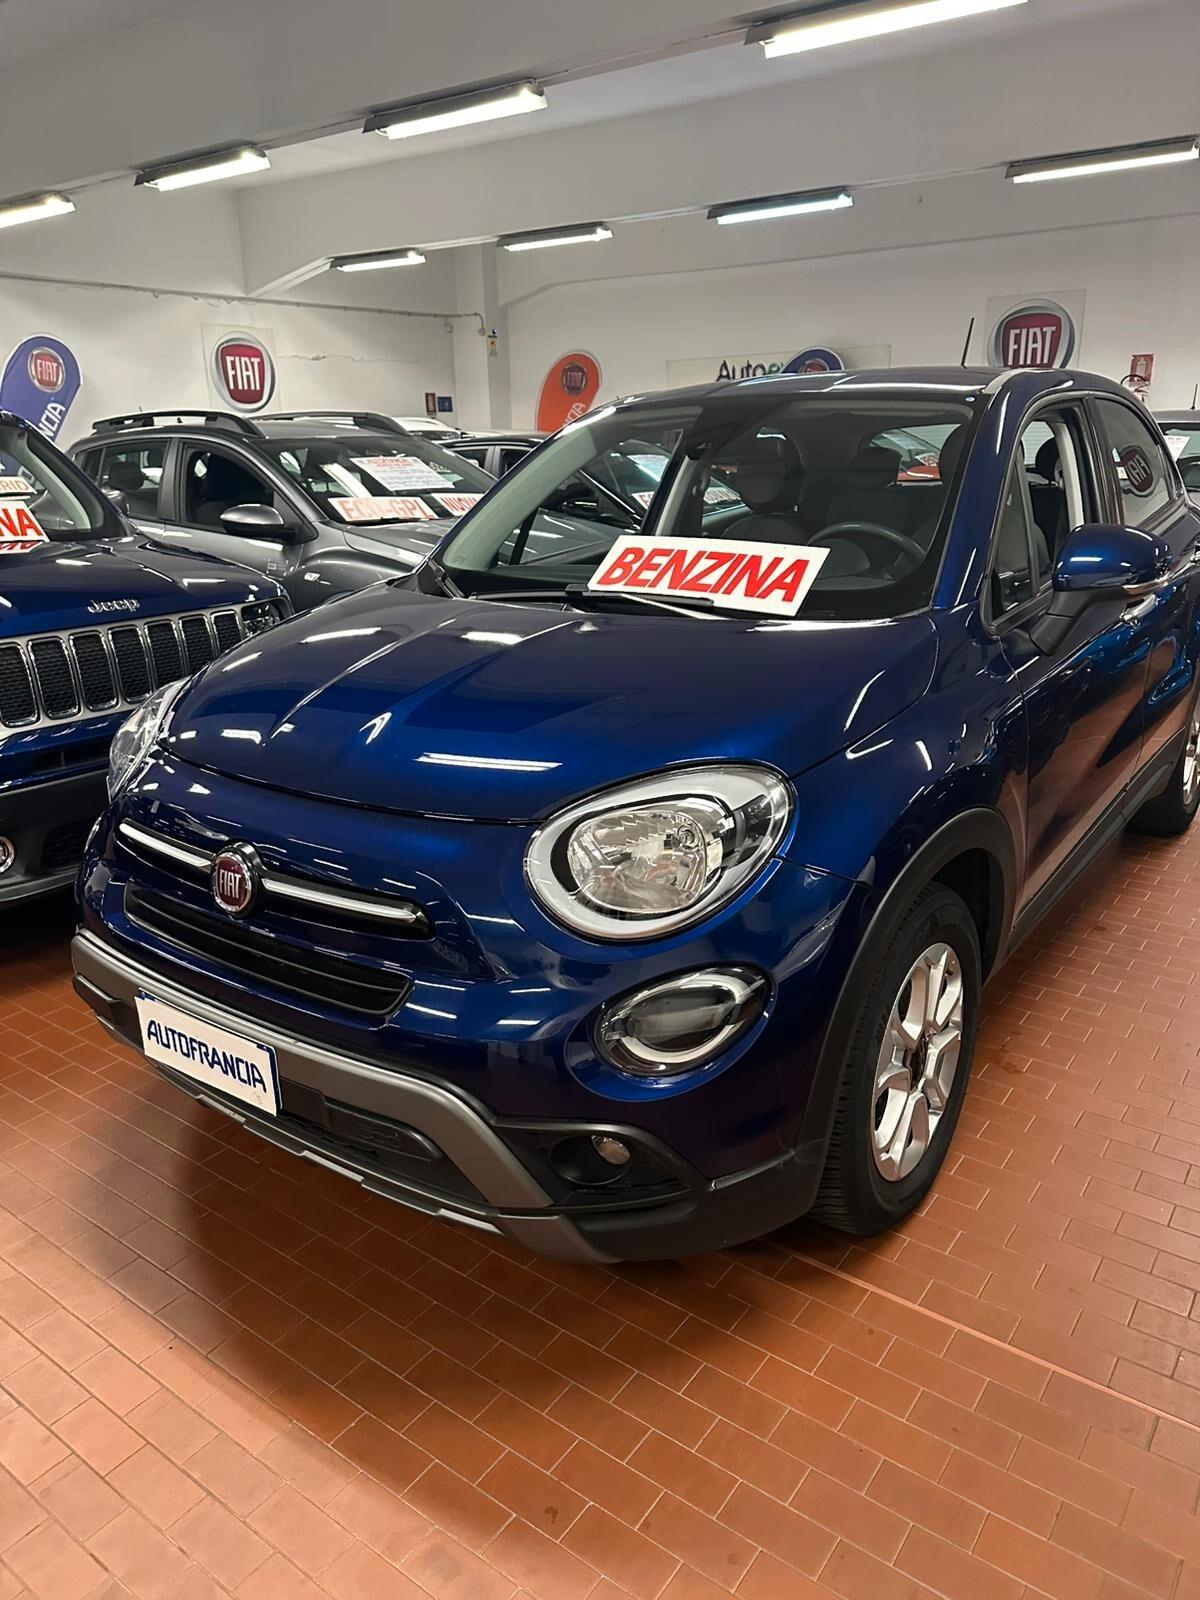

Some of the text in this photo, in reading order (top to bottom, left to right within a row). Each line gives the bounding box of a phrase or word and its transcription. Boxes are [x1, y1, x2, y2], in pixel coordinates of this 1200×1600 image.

[1008, 326, 1057, 366] FIAT
[36, 359, 58, 382] FIAT
[225, 355, 261, 391] FIAT
[715, 359, 784, 382] Autoe
[39, 402, 66, 438] NCIA
[0, 479, 29, 491] RID
[0, 508, 44, 537] NA
[338, 498, 434, 520] ECO-GPL
[596, 546, 810, 603] BENZINA
[87, 599, 140, 613] Jeep
[219, 868, 242, 899] FIAT
[147, 1019, 267, 1094] AUTOFRANCIA
